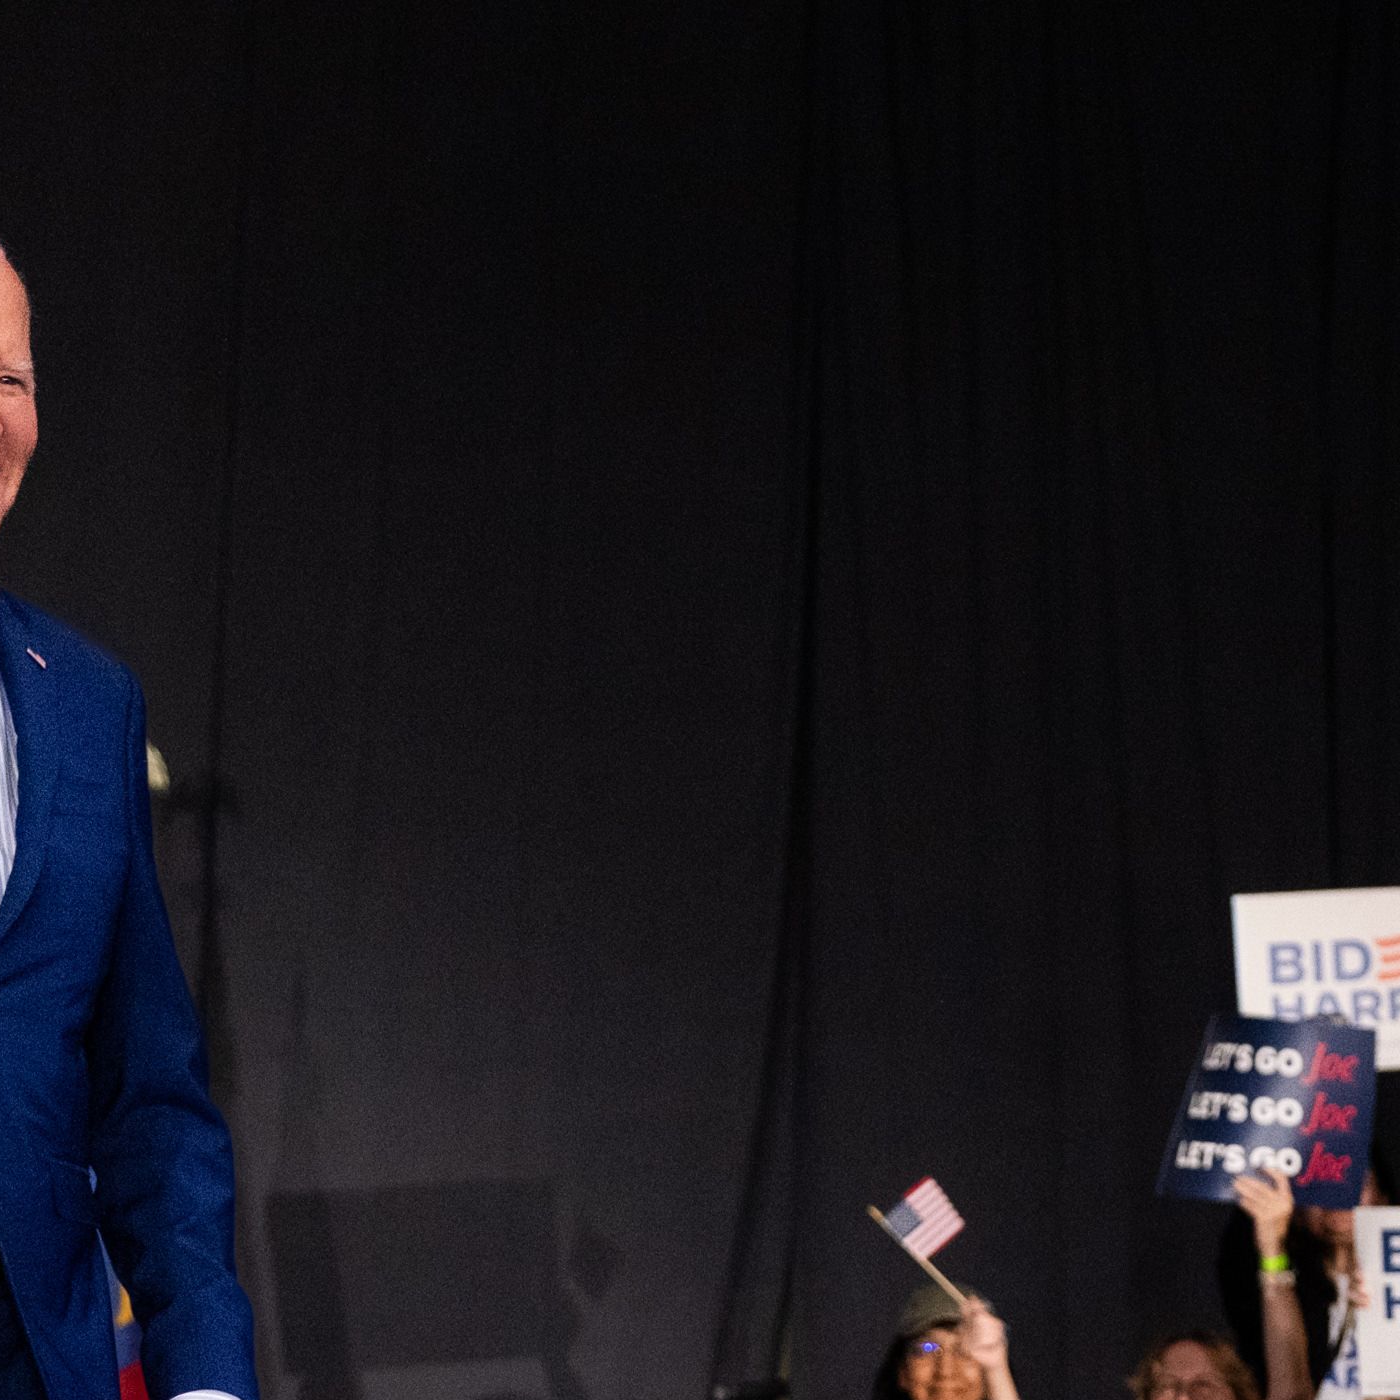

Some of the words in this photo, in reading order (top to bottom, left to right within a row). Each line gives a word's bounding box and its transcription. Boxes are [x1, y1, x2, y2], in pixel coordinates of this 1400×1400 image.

[1202, 1040, 1254, 1071] LET'S
[1254, 1044, 1302, 1079] GO
[1304, 1041, 1360, 1087] Joe
[1188, 1090, 1250, 1124] LET'S
[1250, 1096, 1304, 1129] GO
[1302, 1091, 1359, 1136] Joe
[1174, 1139, 1247, 1175] LET'S
[1297, 1141, 1353, 1187] Joe
